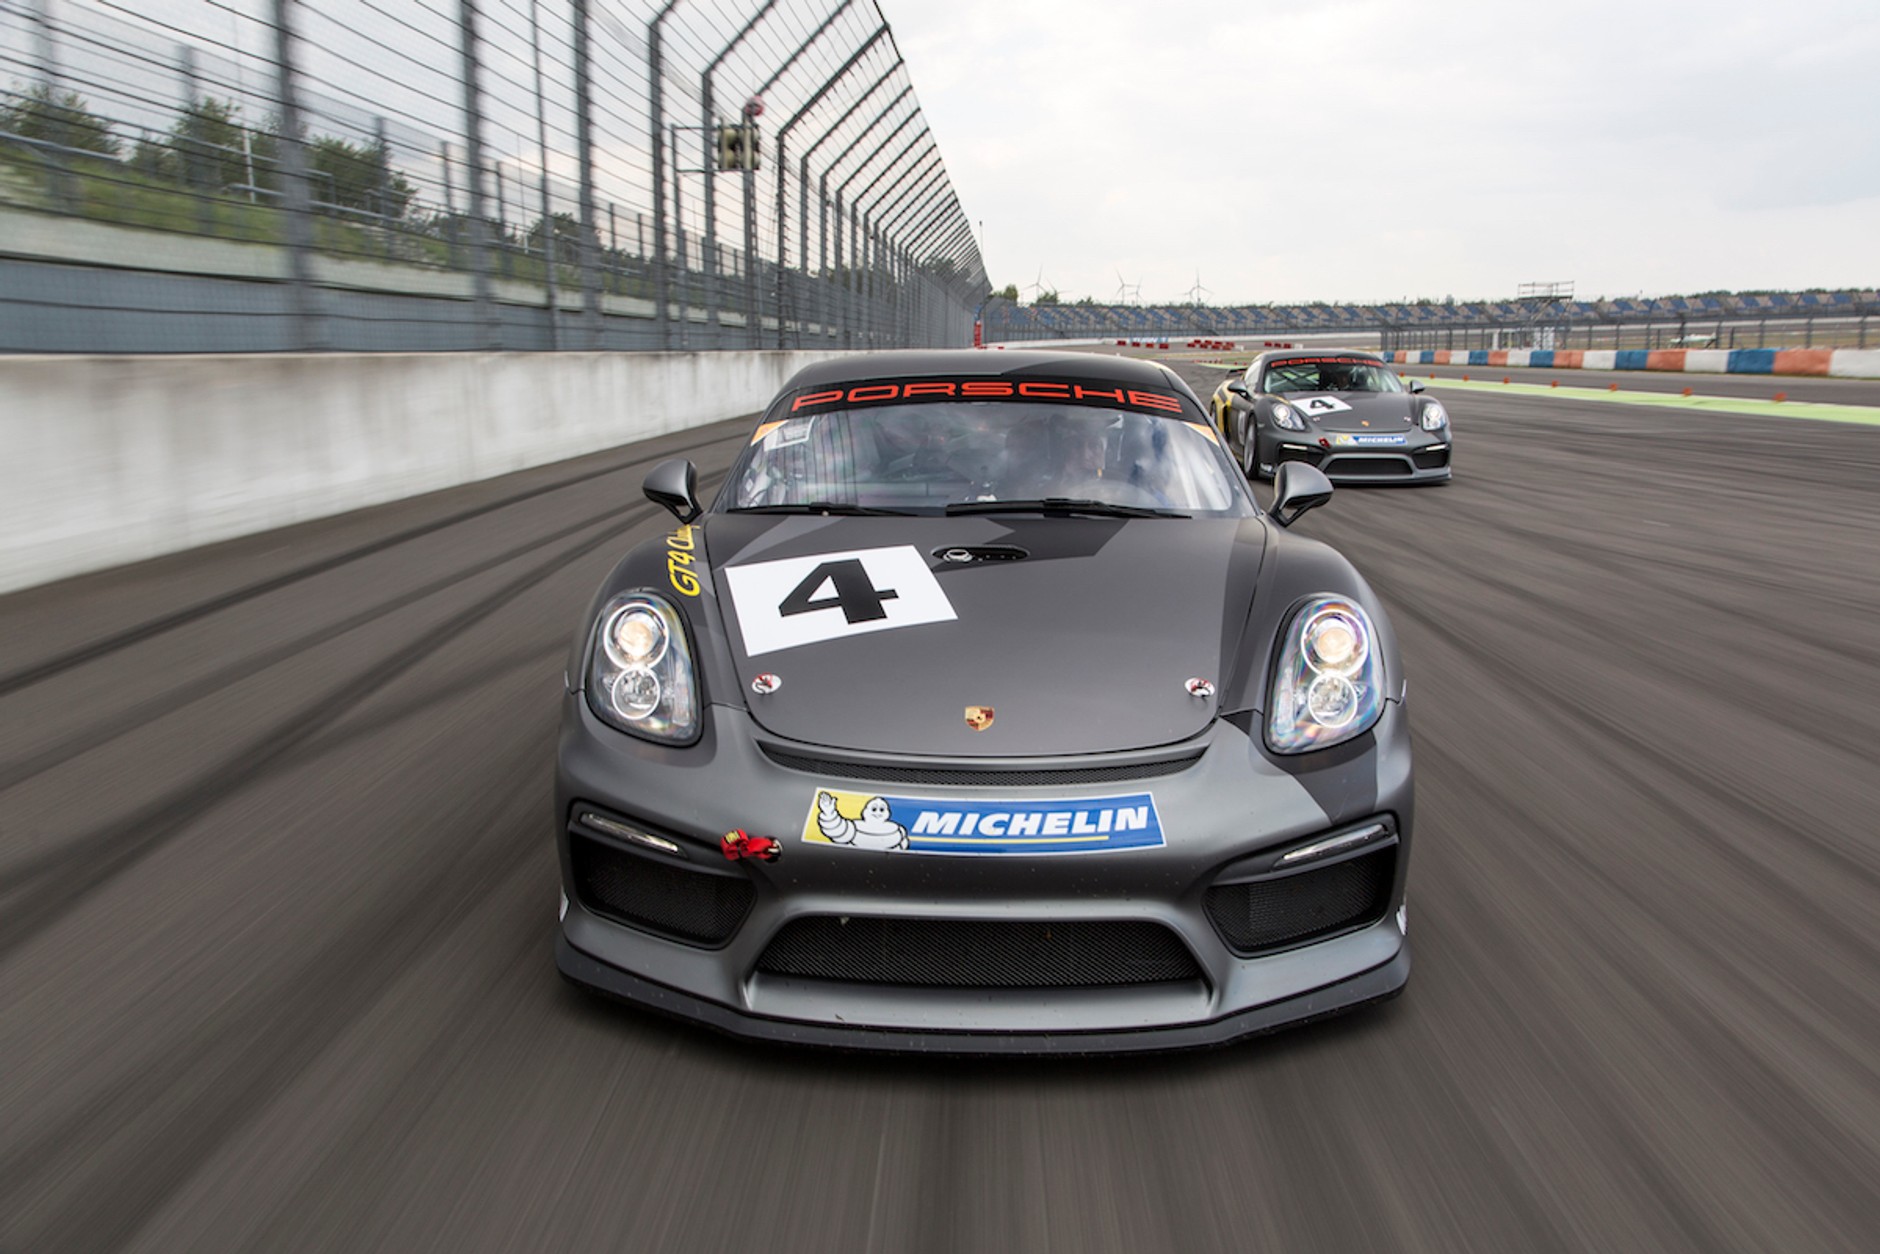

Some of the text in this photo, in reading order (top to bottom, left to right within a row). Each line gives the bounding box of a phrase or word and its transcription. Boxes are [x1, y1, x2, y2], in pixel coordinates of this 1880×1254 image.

[791, 382, 1183, 414] PORSCHE
[1310, 399, 1335, 409] 4
[667, 550, 701, 597] GT4
[778, 558, 899, 625] 4
[910, 806, 1149, 837] MICHELIN
